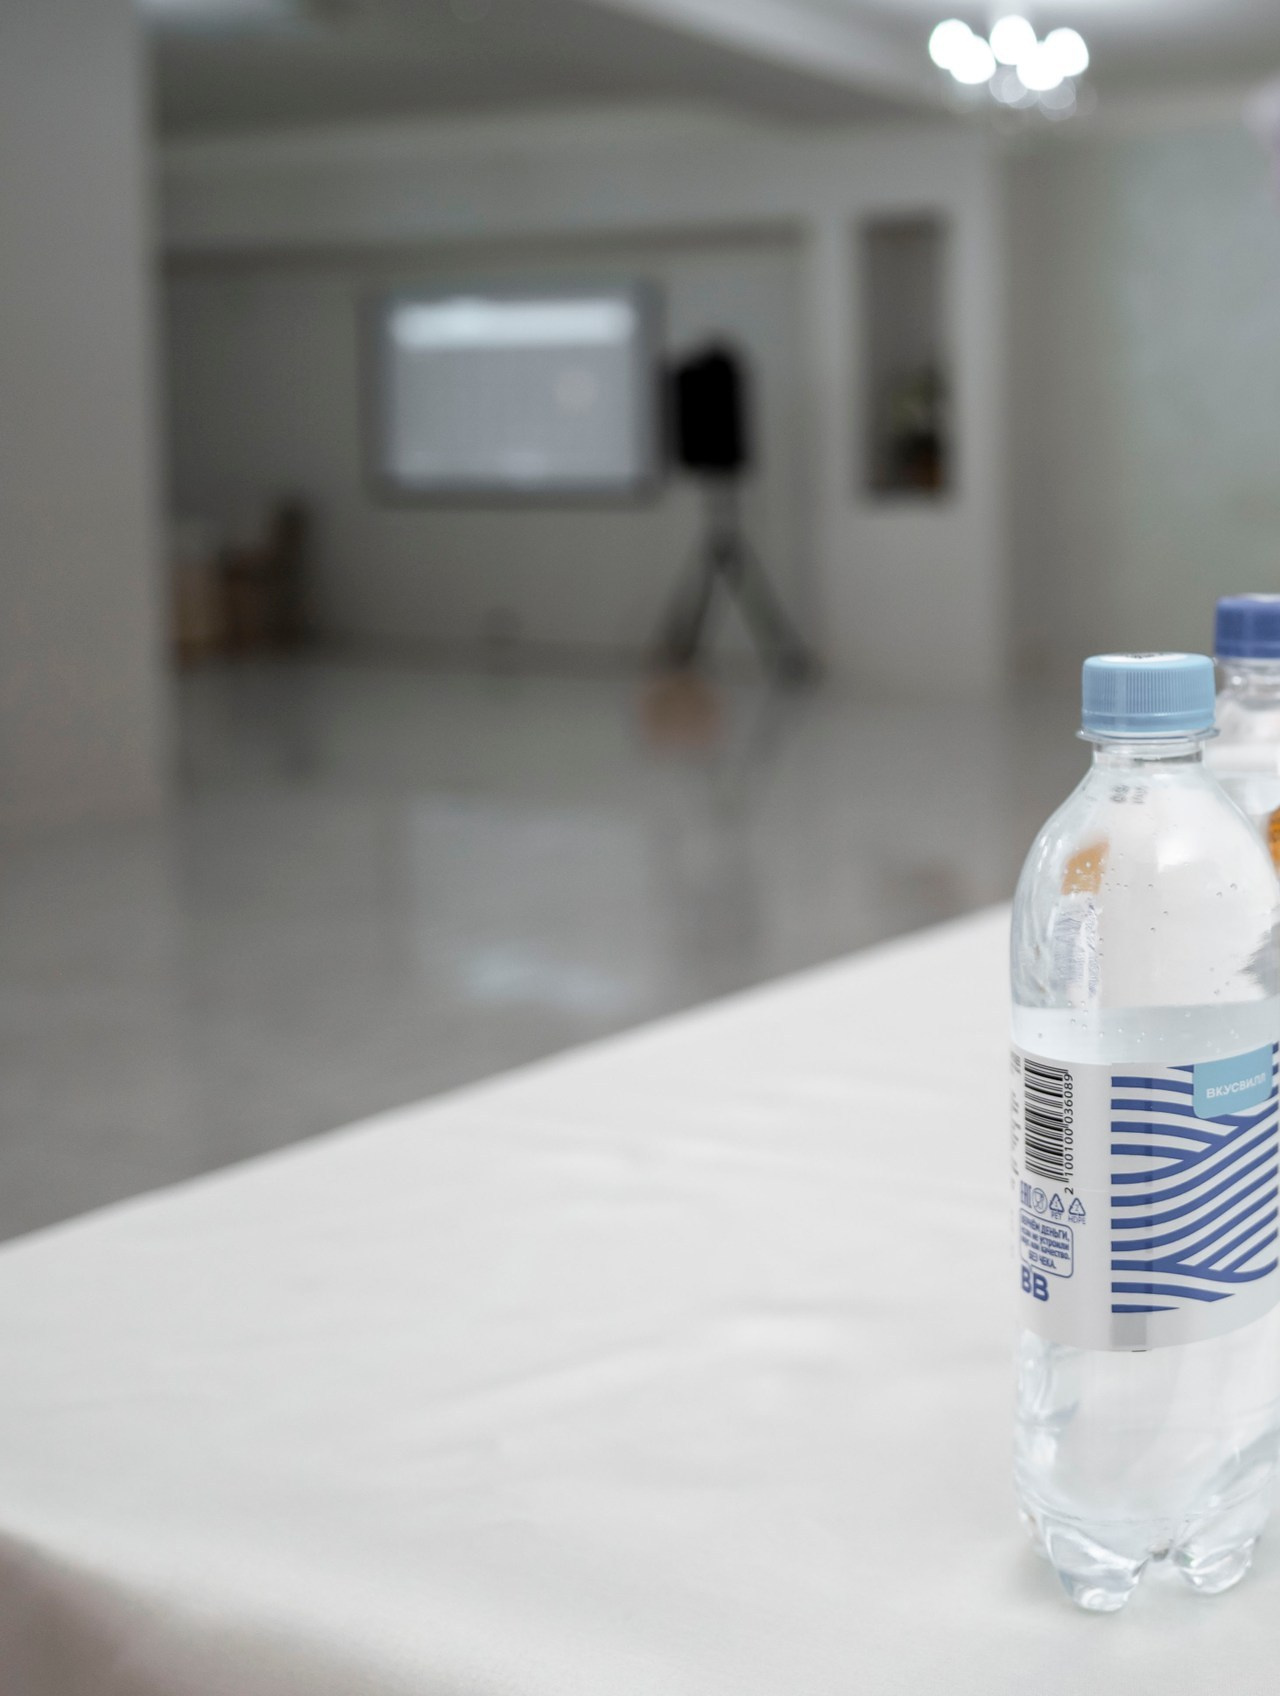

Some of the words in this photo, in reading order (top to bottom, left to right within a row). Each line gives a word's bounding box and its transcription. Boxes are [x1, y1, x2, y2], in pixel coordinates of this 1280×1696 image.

[1064, 1074, 1074, 1124] 036089
[1064, 1128, 1074, 1178] 100100
[1064, 1186, 1074, 1196] 2
